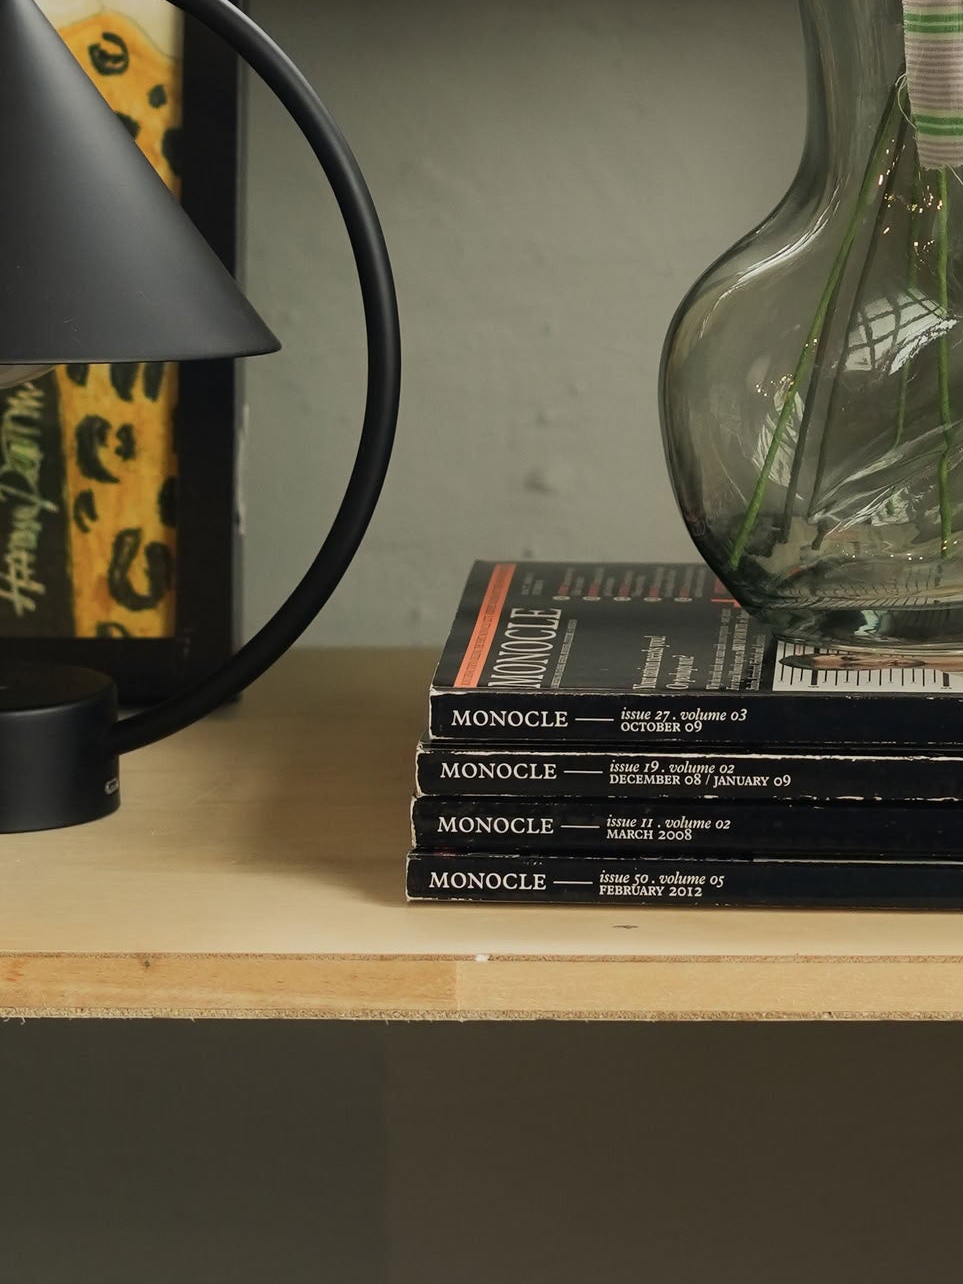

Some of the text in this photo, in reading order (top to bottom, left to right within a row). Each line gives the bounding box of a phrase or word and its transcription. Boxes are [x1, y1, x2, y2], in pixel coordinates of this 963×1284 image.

[487, 607, 562, 689] MONOCLE
[451, 709, 569, 728] MONOCLE
[620, 706, 748, 723] issue 27 volume 03
[620, 720, 703, 733] OCTOBER 09
[439, 762, 557, 780] MONOCLE
[609, 759, 735, 774] issue 19 volume 02
[609, 773, 681, 785] DECEMBER
[684, 773, 702, 786] 08
[712, 775, 770, 789] JANUARY
[773, 774, 792, 787] 09
[436, 816, 554, 834] MONOCLE
[606, 814, 637, 828] issue
[664, 815, 712, 829] volume
[715, 819, 731, 830] 02
[606, 828, 693, 841] MARCH 2008
[429, 871, 547, 890] MONOCLE
[599, 869, 725, 889] issue 50 volume 05
[599, 885, 703, 897] FEBRUARY 2012
